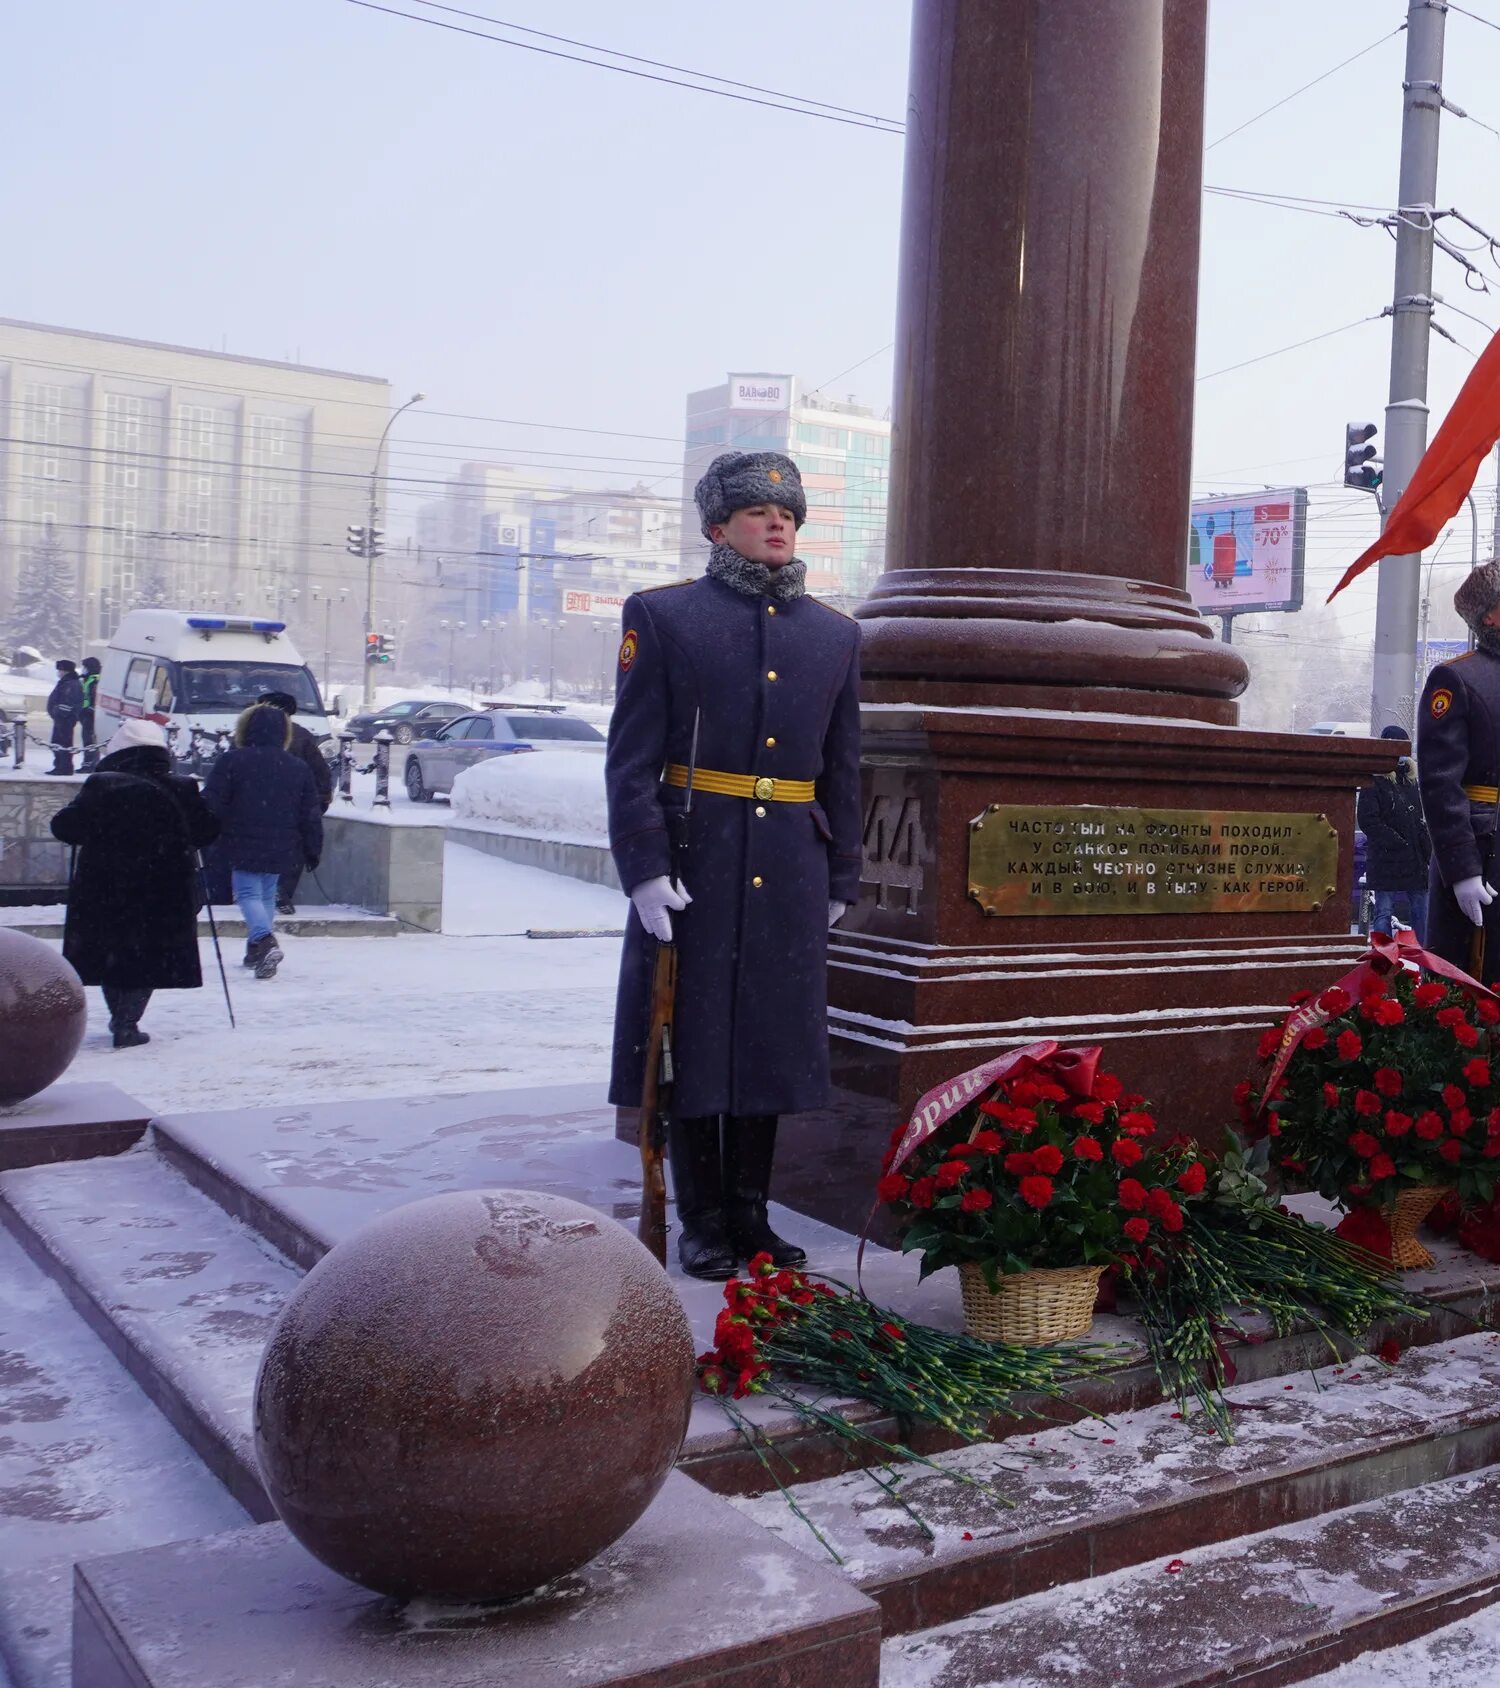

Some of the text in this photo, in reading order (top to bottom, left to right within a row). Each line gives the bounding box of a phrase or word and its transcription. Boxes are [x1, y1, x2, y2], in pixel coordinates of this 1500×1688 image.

[1009, 821, 1064, 835] ЧАСТО
[1071, 822, 1104, 835] ТЫЛ
[1116, 823, 1135, 835] НА
[1145, 824, 1212, 837] ФРОНТЫ
[1221, 826, 1292, 839] ПОХОДИЛ
[1033, 842, 1285, 856] У СТАНКОВ ПОГИБАЛИ ПОРОЙ.
[1007, 860, 1082, 876] КАЖДЫЙ
[1092, 862, 1156, 875] ЧЕСТНО
[1165, 863, 1236, 875] ОТЧИЗНЕ
[1031, 882, 1042, 894] И
[1053, 882, 1062, 894] В
[1127, 882, 1137, 894] И
[1146, 882, 1156, 894] В
[1165, 880, 1208, 894] ТЫЛУ
[1223, 881, 1251, 893] КАК
[1259, 879, 1309, 893] ГЕРОЙ.
